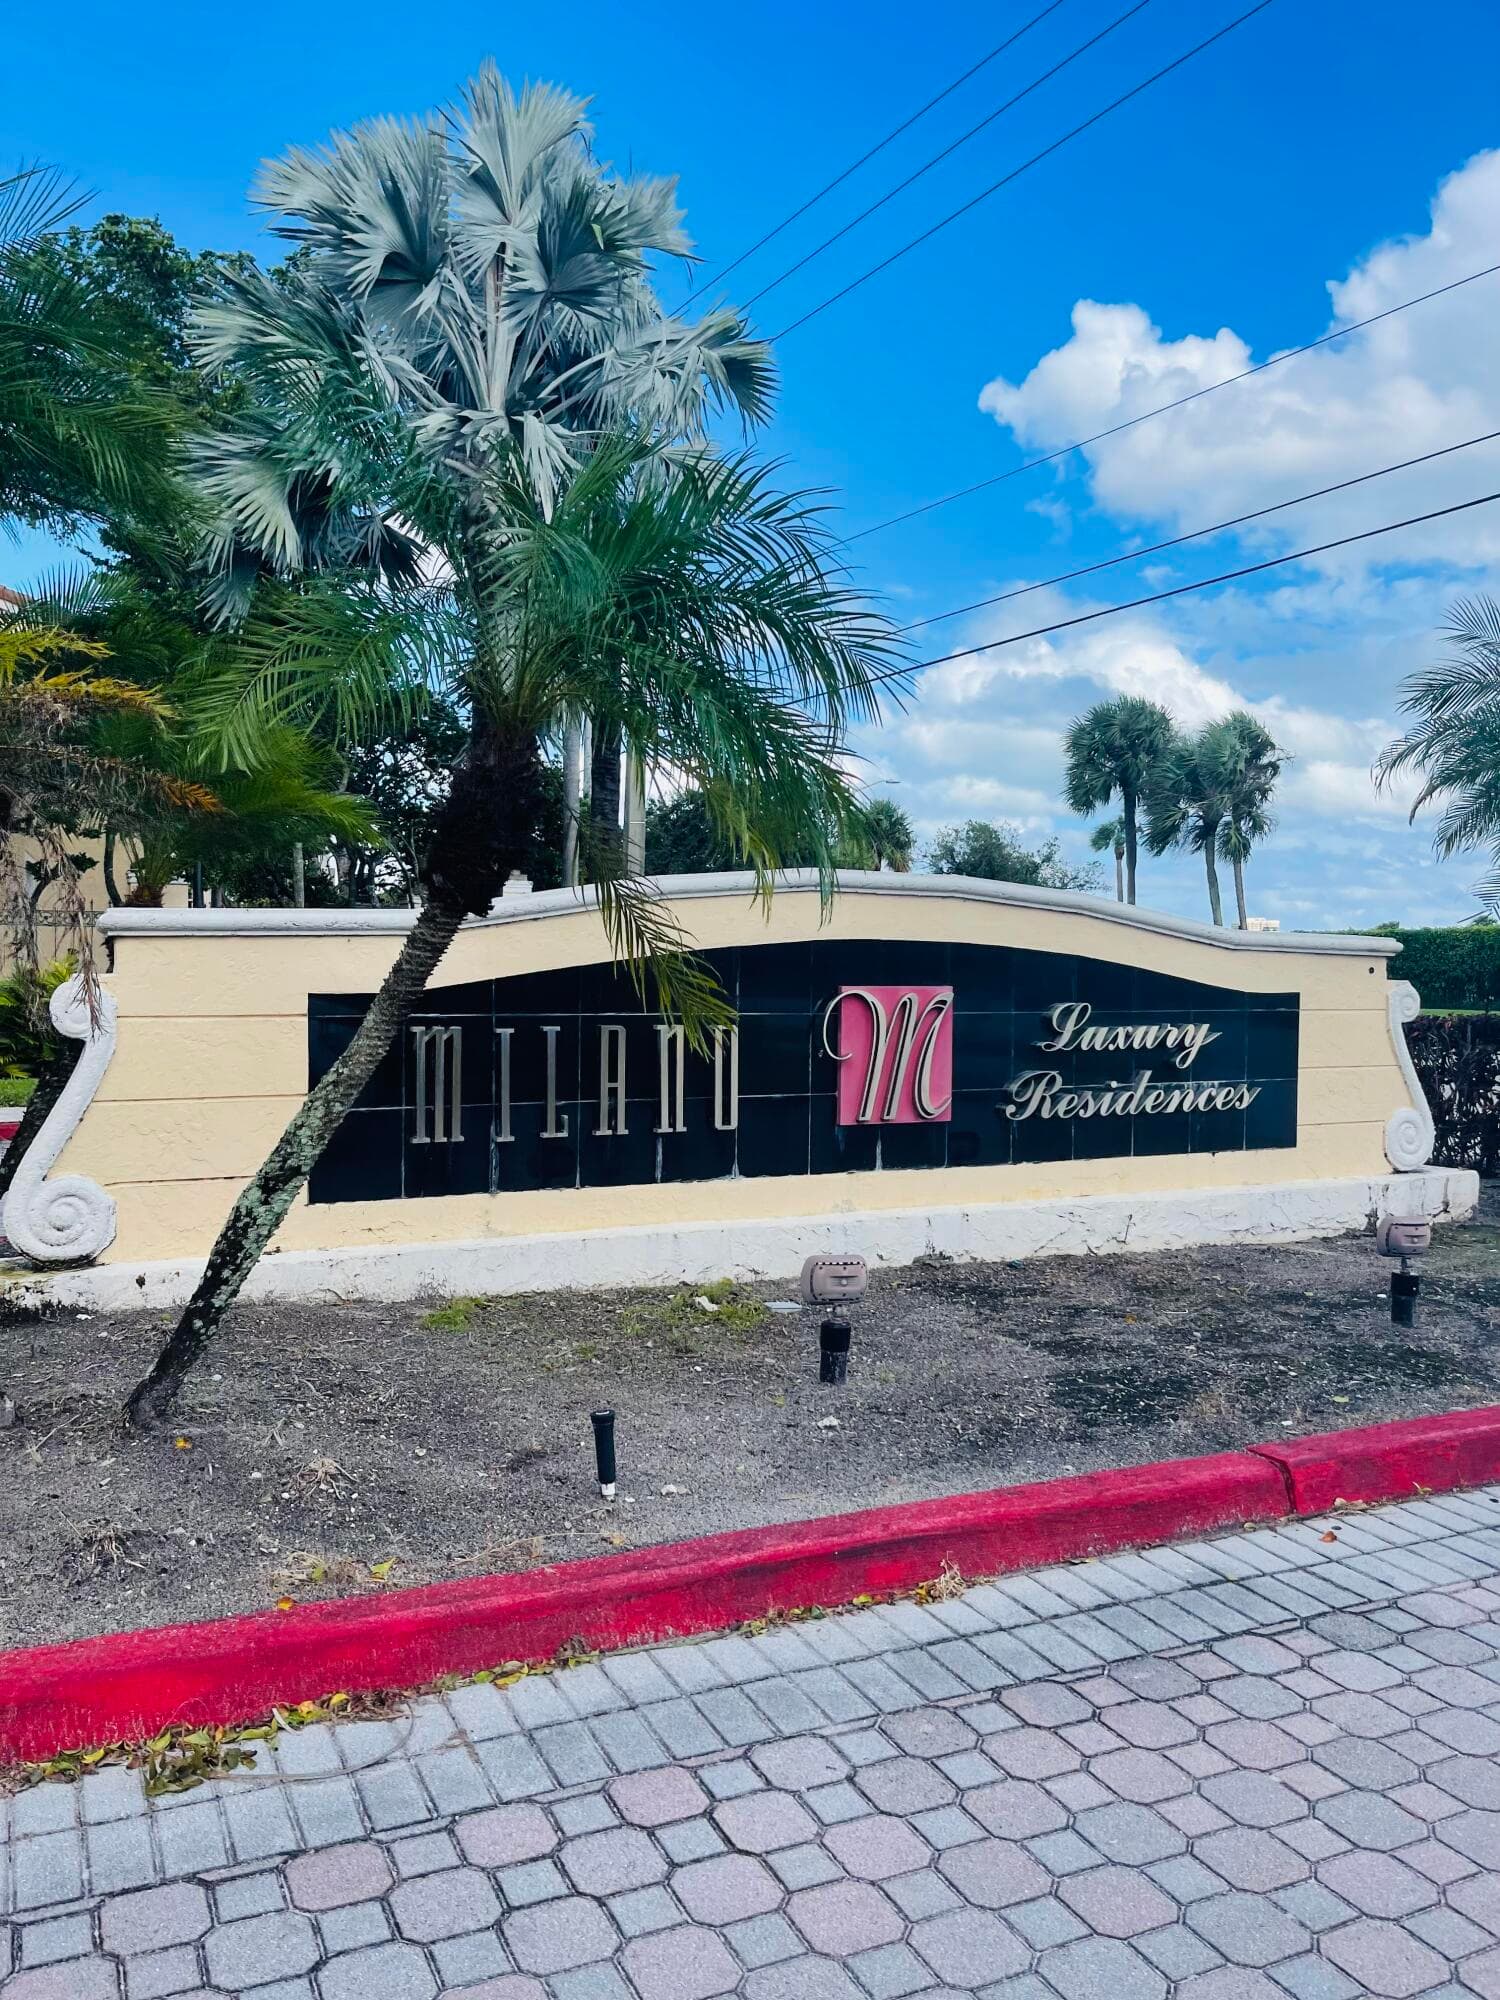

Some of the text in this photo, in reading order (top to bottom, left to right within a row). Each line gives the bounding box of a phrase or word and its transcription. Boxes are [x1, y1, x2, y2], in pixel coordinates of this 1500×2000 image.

[823, 989, 954, 1124] M
[1041, 1002, 1222, 1069] Luxury
[410, 1024, 739, 1143] MILANO
[1005, 1069, 1261, 1121] Residences
